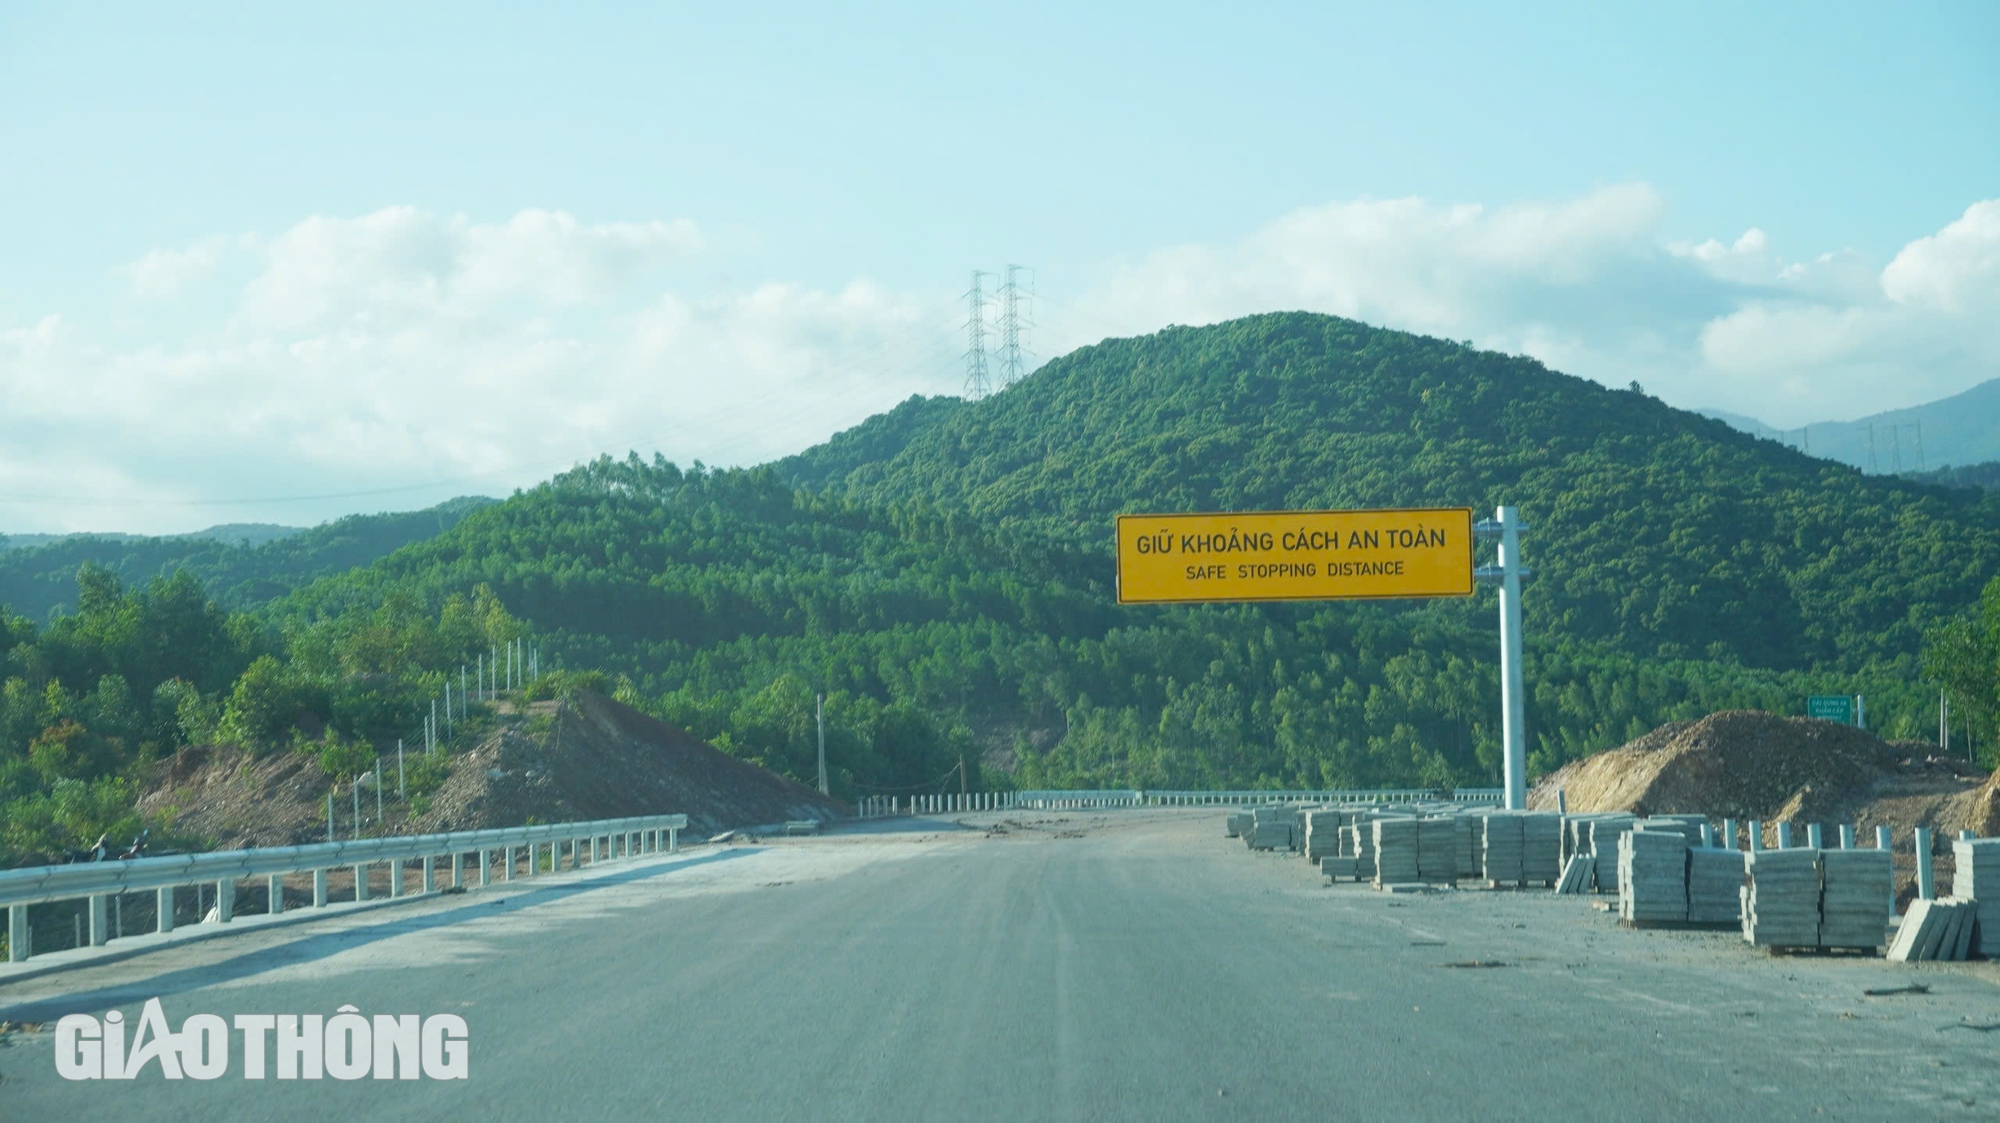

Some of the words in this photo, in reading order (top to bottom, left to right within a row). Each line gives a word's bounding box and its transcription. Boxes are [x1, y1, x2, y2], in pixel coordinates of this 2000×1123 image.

[1137, 529, 1174, 554] GIỮ
[1181, 527, 1274, 554] KHOẢNG
[1282, 527, 1339, 551] CÁCH
[1348, 530, 1379, 549] AN
[1386, 524, 1445, 548] TOÀN
[1186, 565, 1226, 580] SAFE
[1238, 563, 1316, 579] STOPPING
[1327, 560, 1404, 577] DISTANCE
